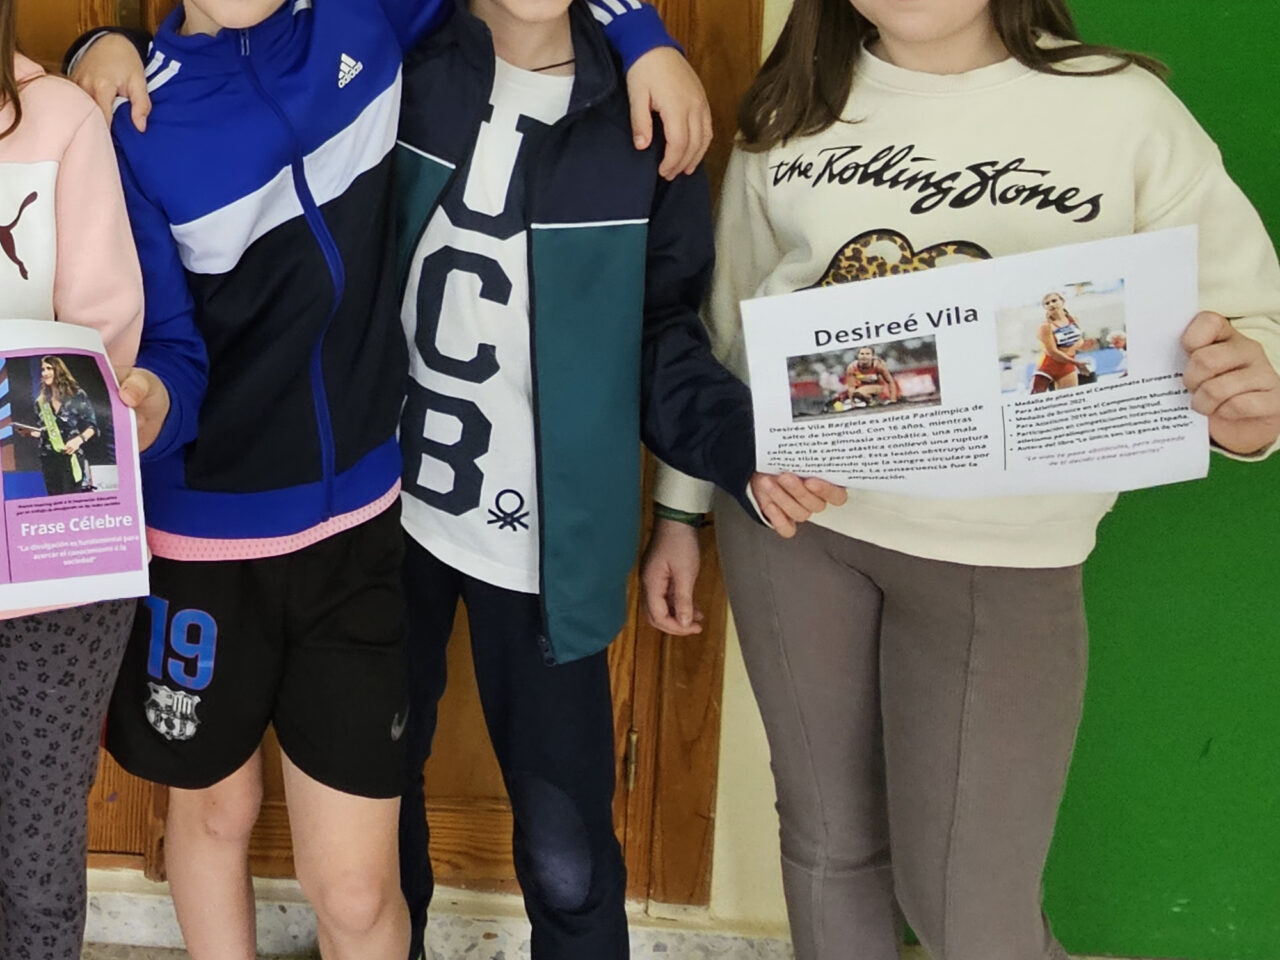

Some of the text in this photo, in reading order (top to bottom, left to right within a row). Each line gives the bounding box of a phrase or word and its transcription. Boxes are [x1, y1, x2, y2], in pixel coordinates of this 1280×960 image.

[337, 60, 363, 89] adidas
[814, 143, 960, 215] Rolling
[951, 157, 1104, 223] Stones
[814, 305, 979, 347] Desireé Vila
[971, 404, 984, 412] de
[20, 514, 133, 537] Frase Célebre
[144, 594, 218, 690] 19
